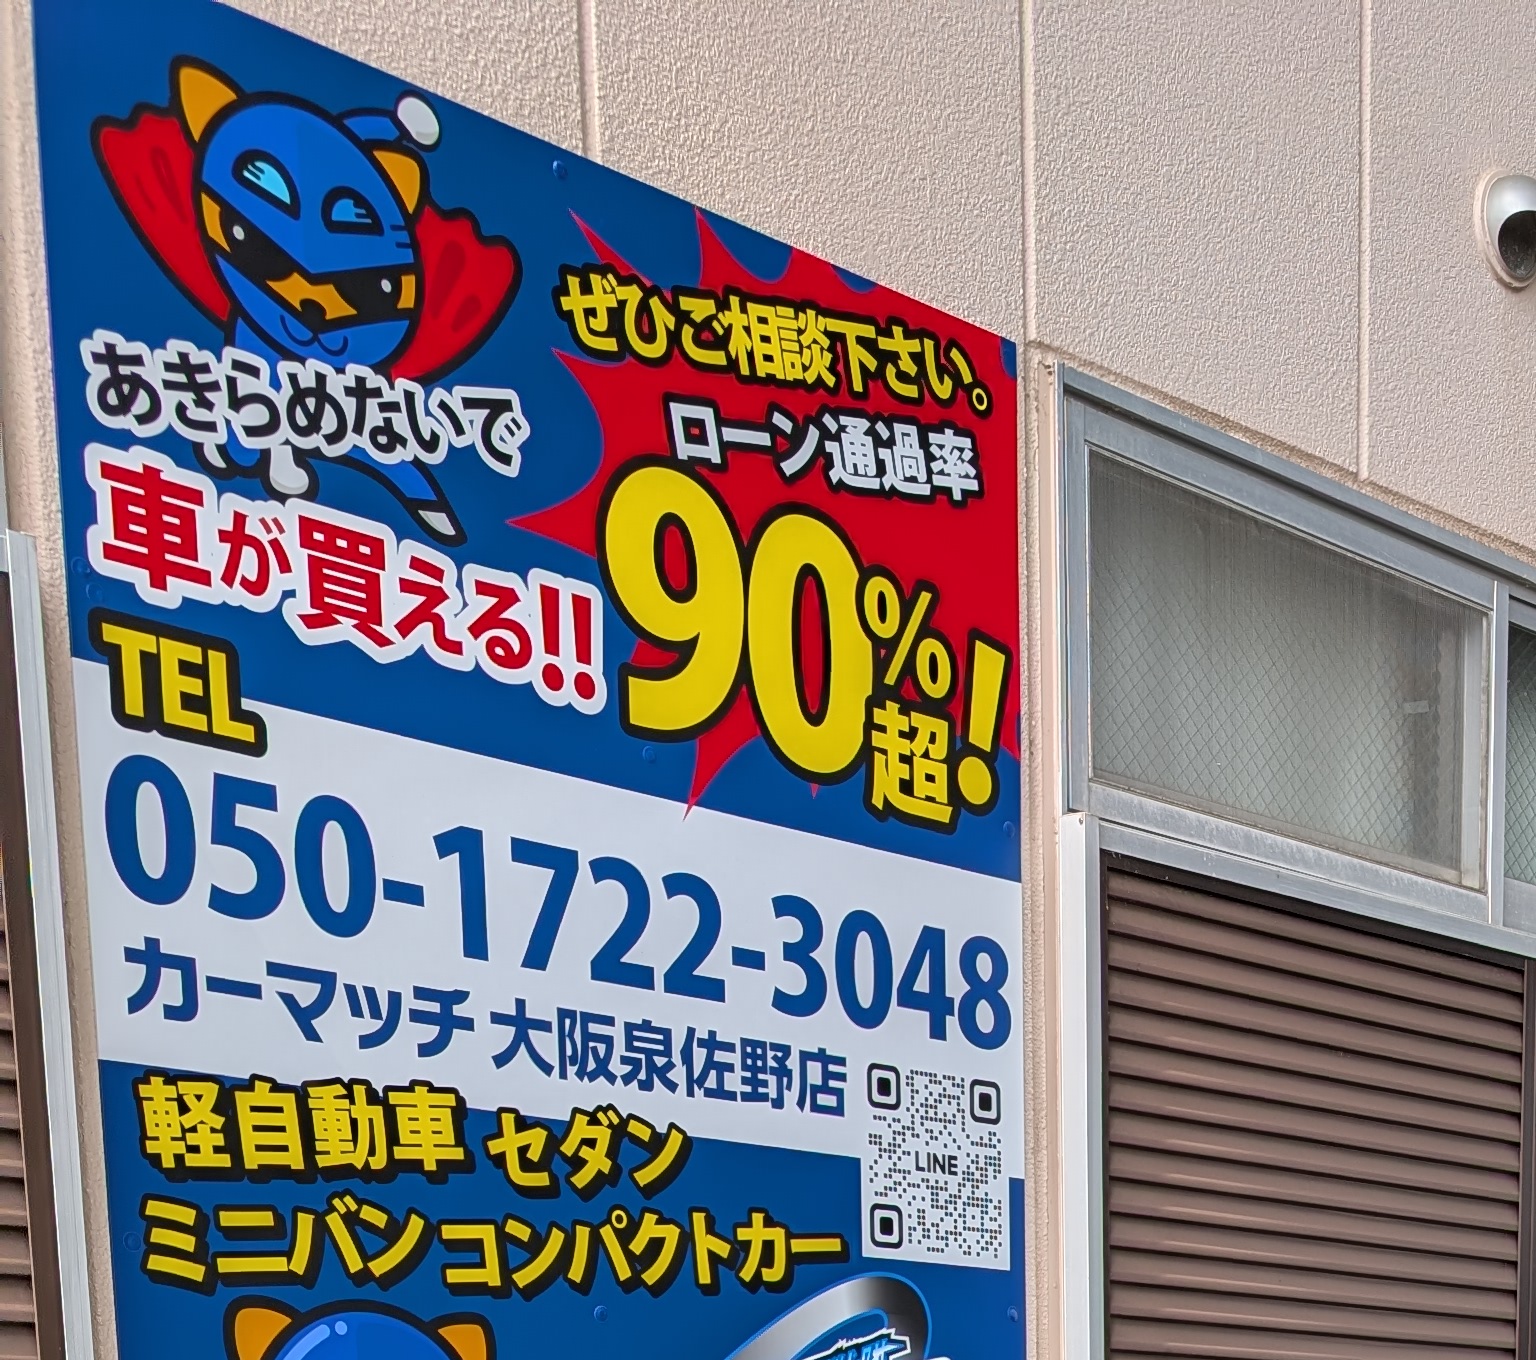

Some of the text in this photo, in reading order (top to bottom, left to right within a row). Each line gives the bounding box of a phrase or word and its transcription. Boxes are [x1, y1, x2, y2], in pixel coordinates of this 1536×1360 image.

[560, 270, 992, 414] ぜひご相談下さい。
[92, 341, 526, 468] あきらめないで
[670, 401, 982, 499] ローン通過率
[101, 621, 258, 745] TEL
[104, 754, 1013, 1052] 050-1722-3048
[123, 935, 849, 1117] カーマッチ 大阪泉佐野店
[142, 1078, 686, 1192] 軽自動車 セダン
[914, 1150, 959, 1177] LINE
[141, 1196, 846, 1290] ミニバン コンパクトカー
